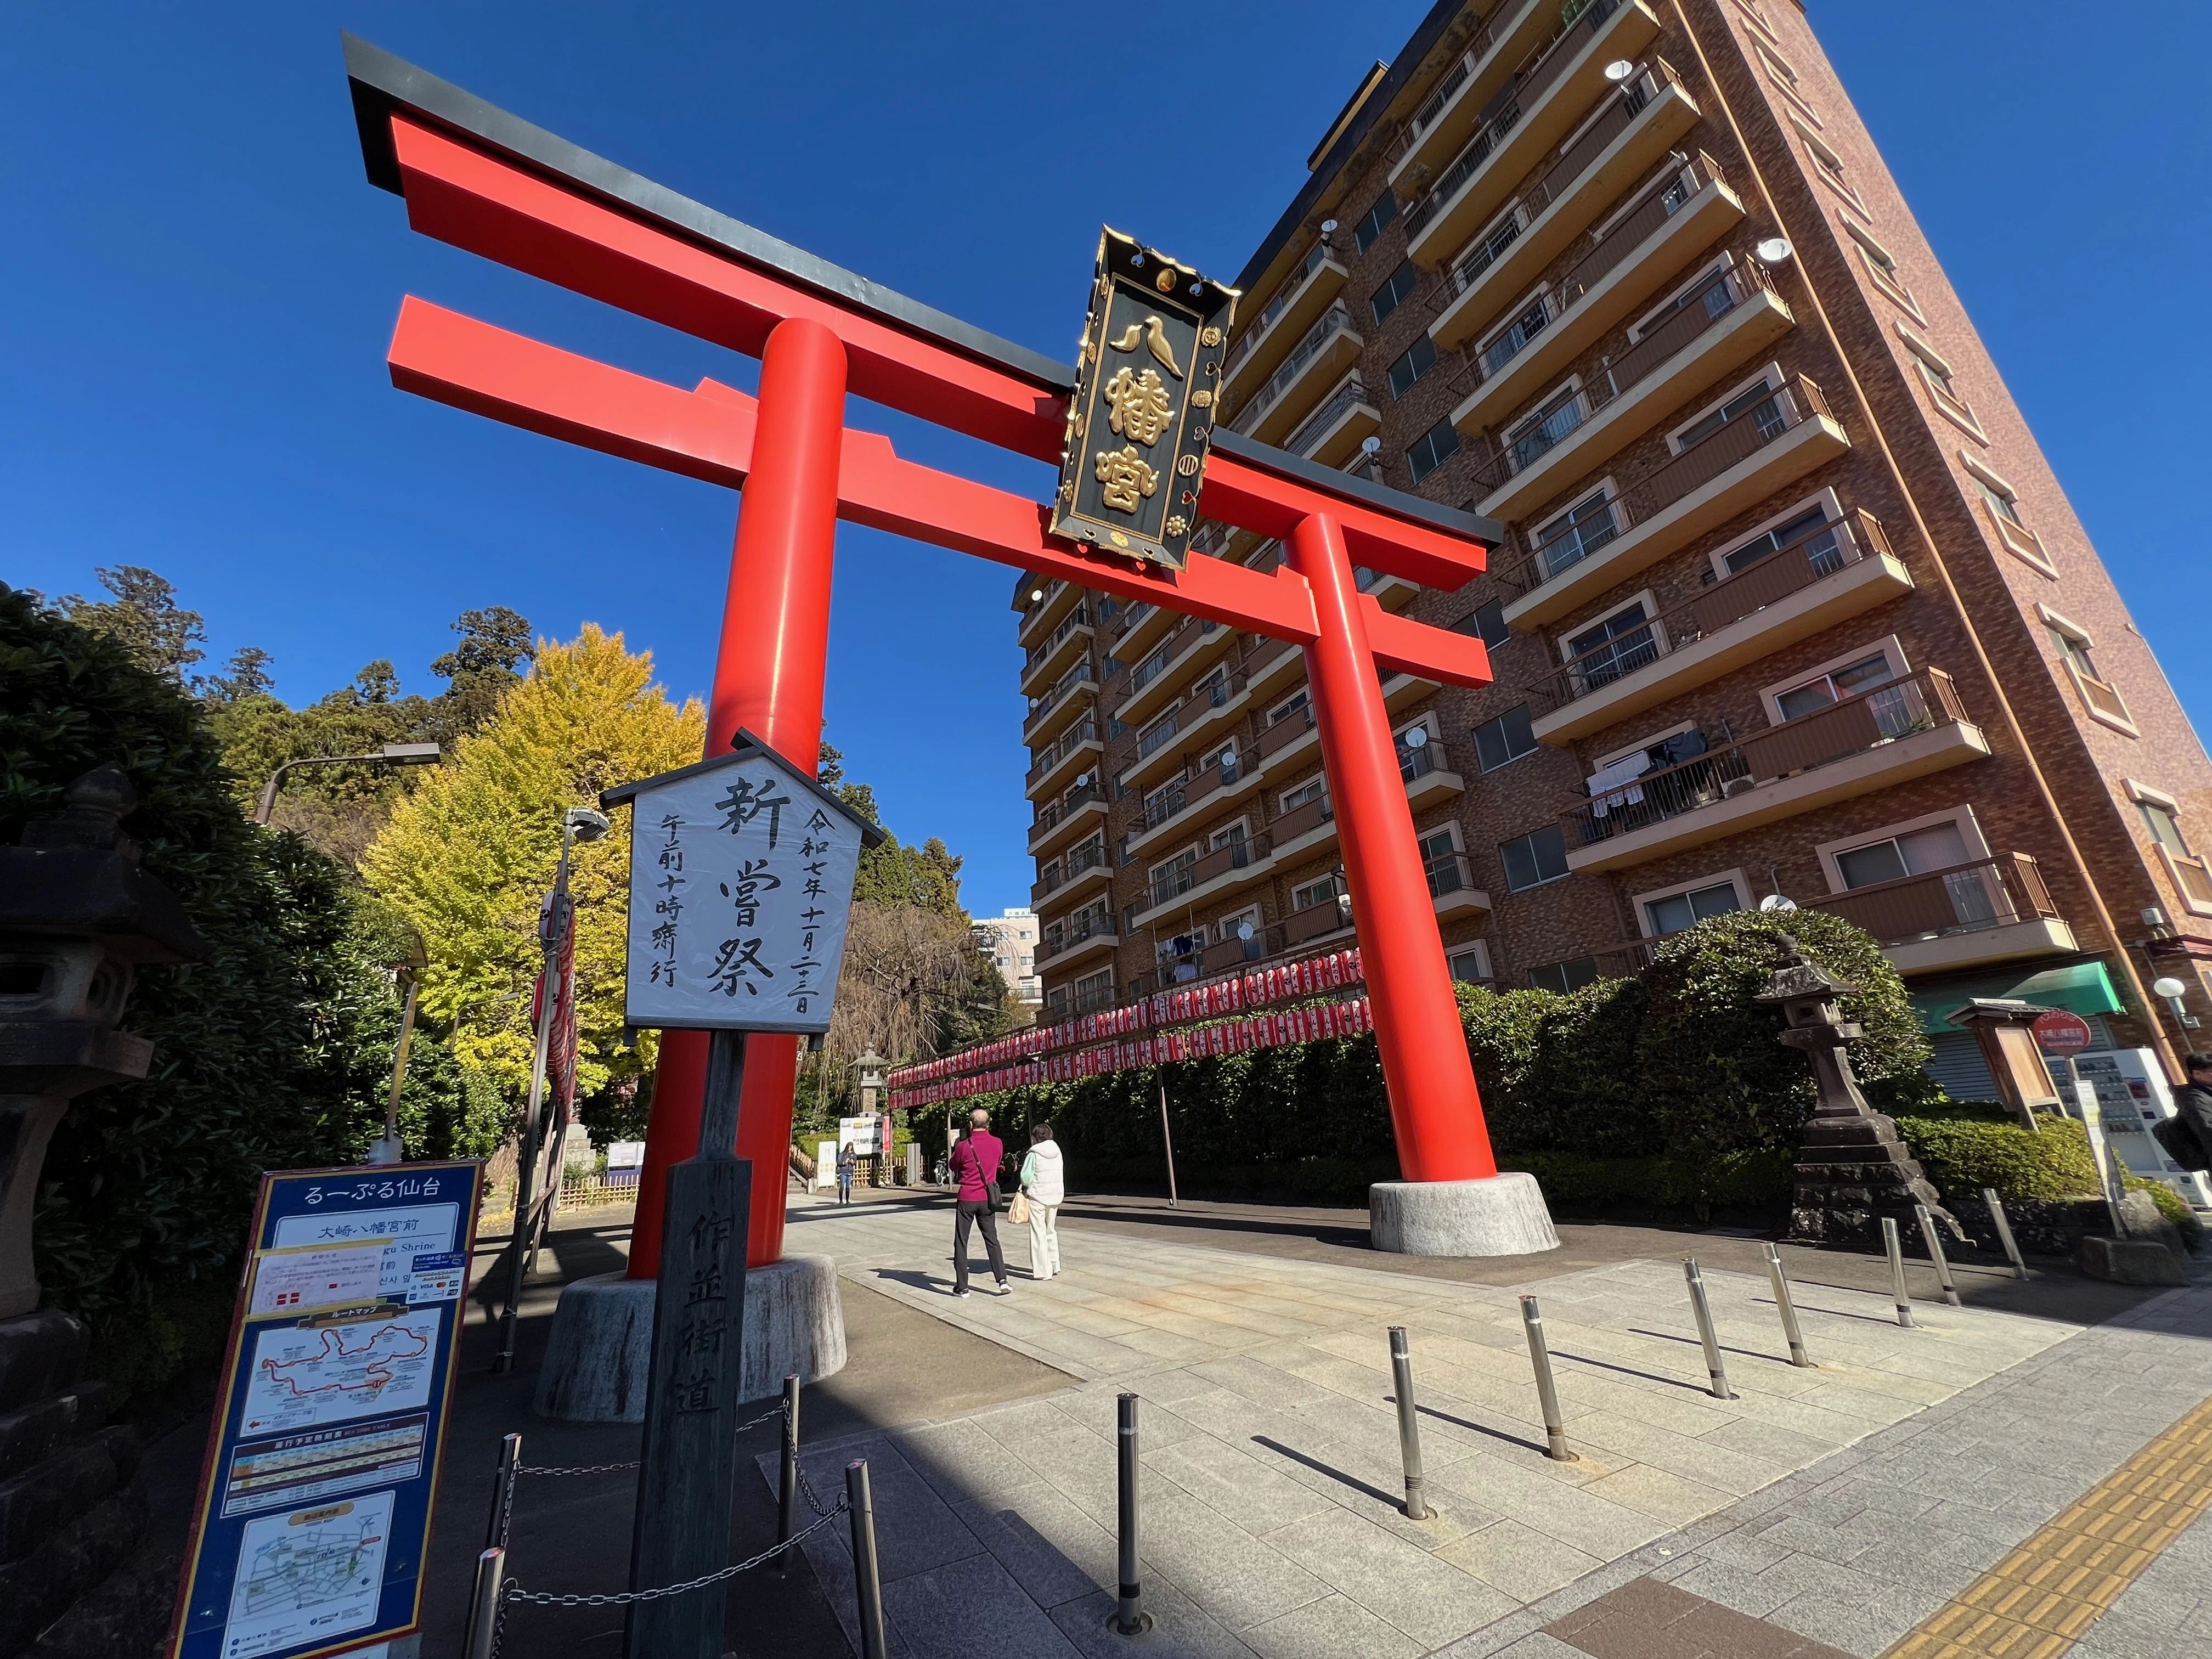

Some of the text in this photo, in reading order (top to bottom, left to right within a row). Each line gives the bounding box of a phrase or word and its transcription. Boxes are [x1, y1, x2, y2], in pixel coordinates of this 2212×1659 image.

[1095, 315, 1184, 515] 八幡宮
[707, 777, 791, 997] 新嘗祭
[787, 808, 836, 1014] 令和七年十一月二十三日
[304, 1177, 441, 1204] るーぷる仙台
[318, 1218, 420, 1239] 大崎八幡宮前
[400, 1242, 436, 1252] Shrine
[331, 1306, 377, 1318] ルートマップ
[675, 1210, 732, 1414] 作並街道
